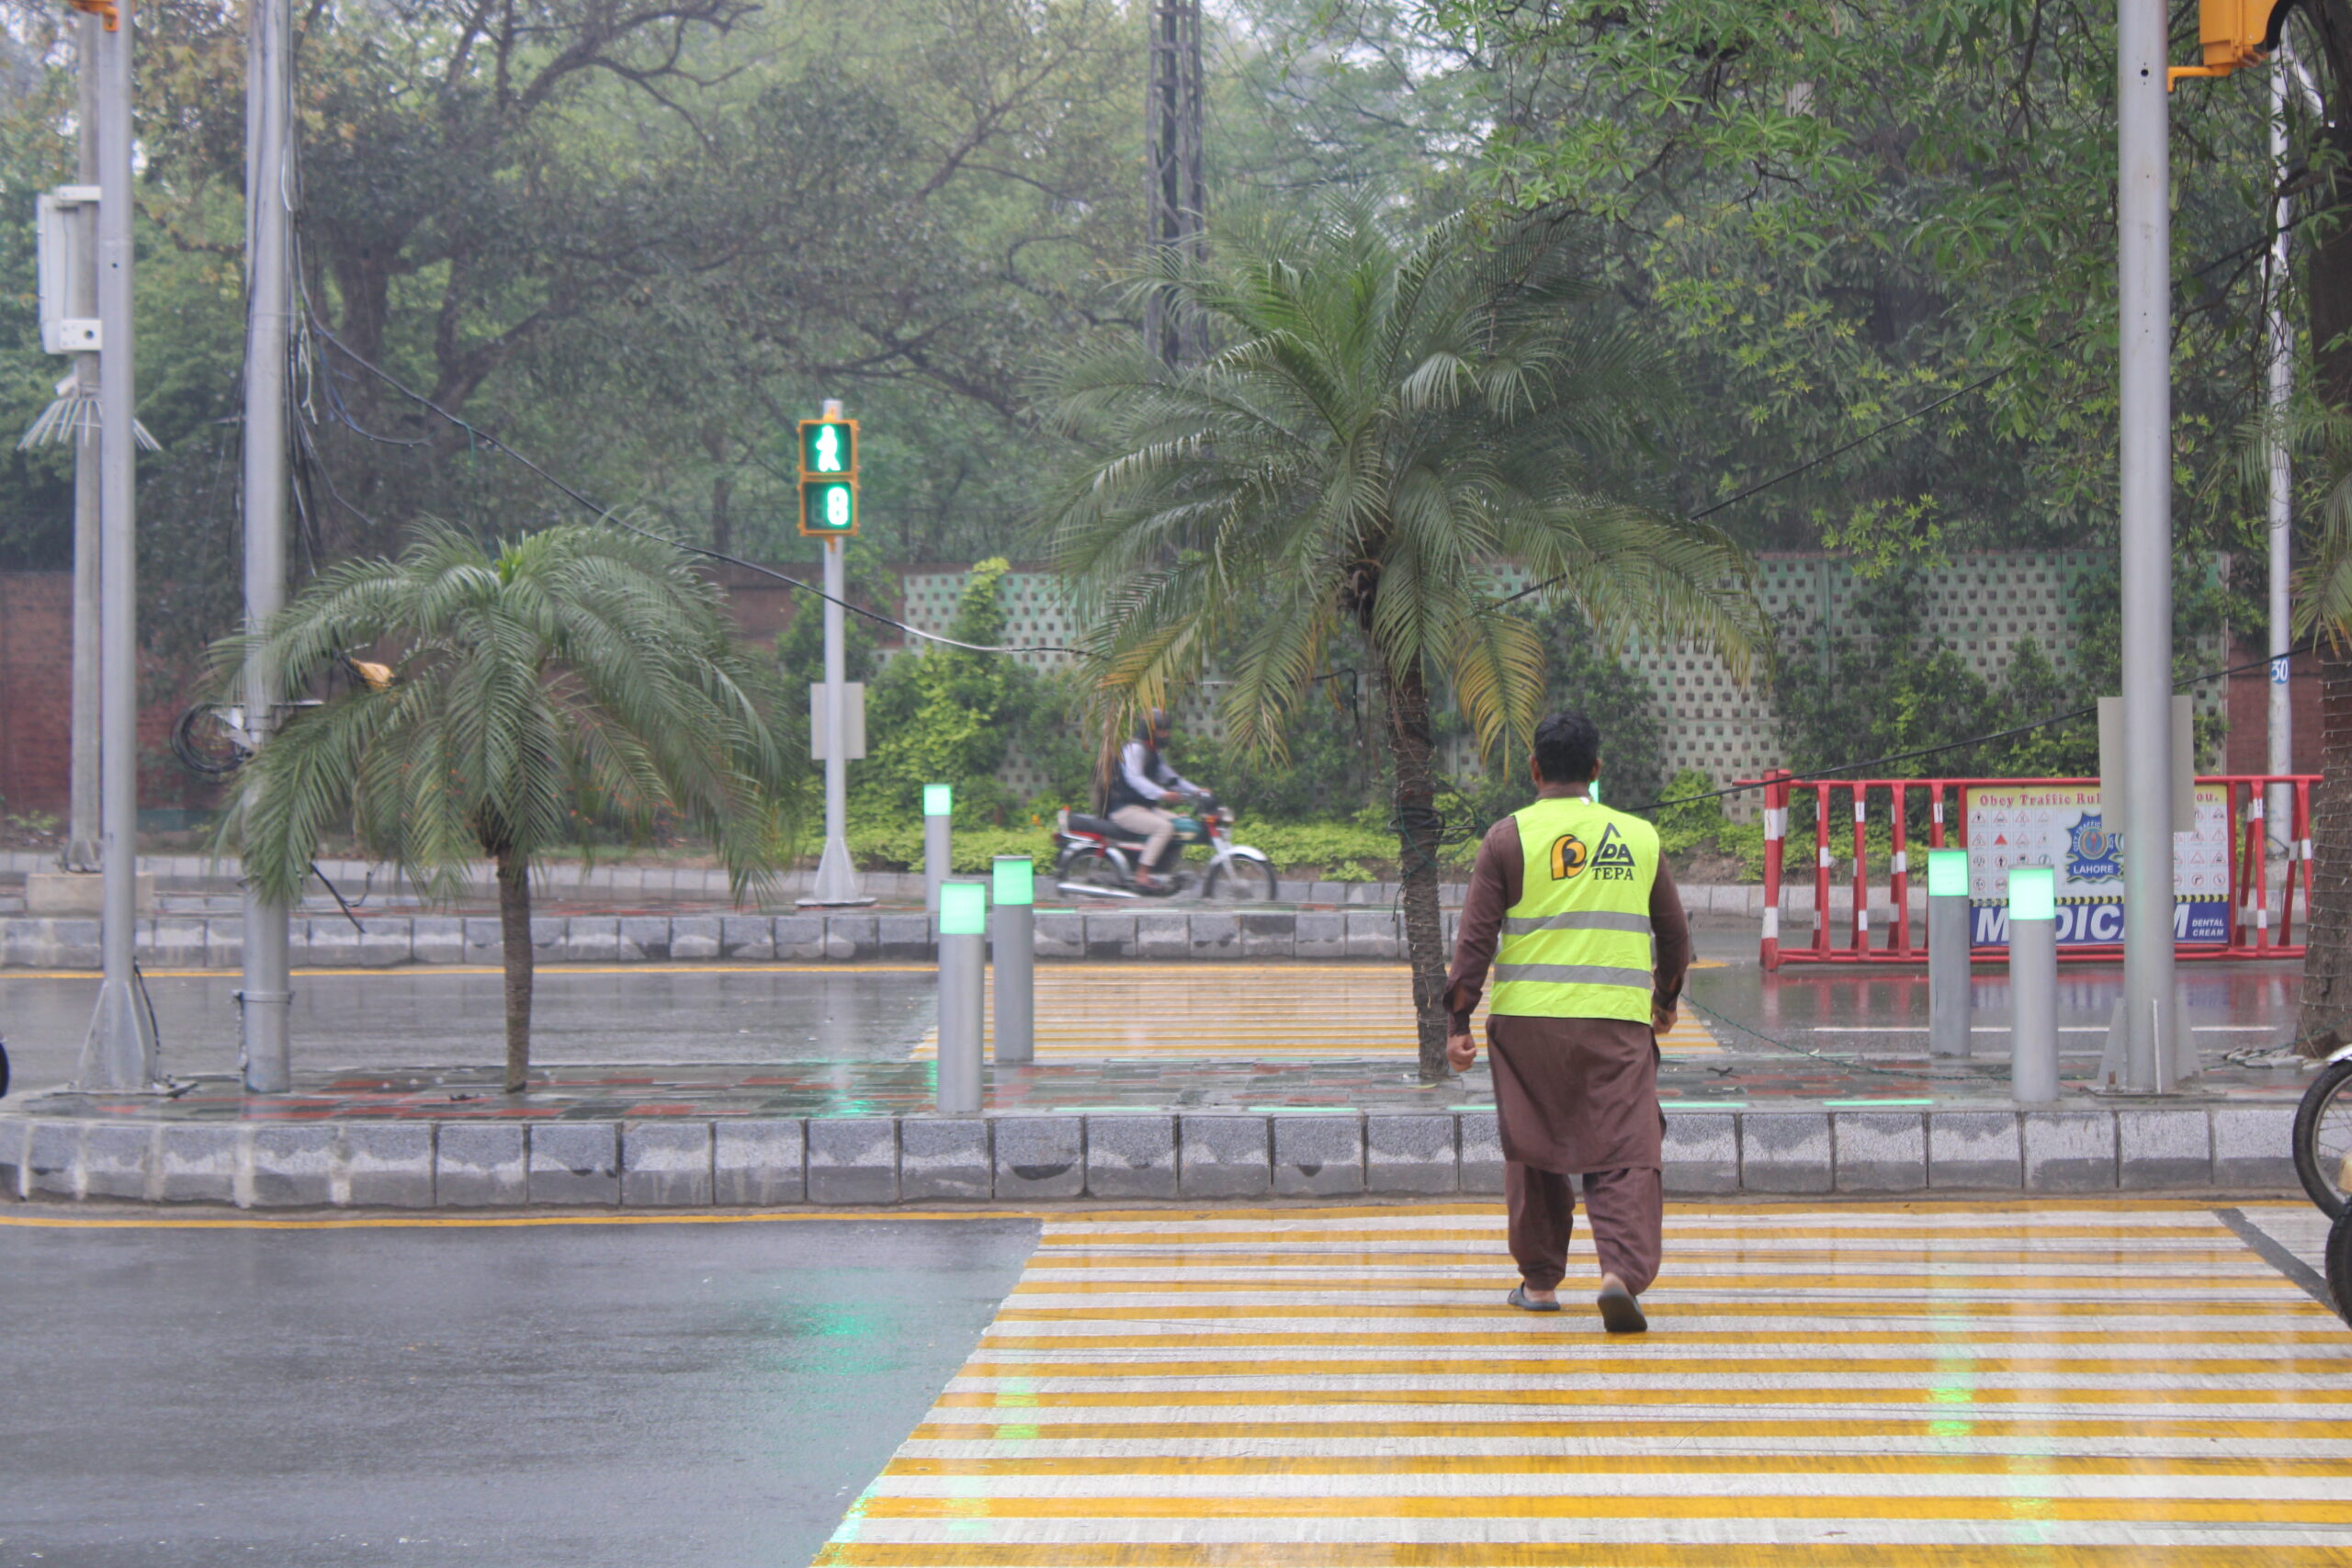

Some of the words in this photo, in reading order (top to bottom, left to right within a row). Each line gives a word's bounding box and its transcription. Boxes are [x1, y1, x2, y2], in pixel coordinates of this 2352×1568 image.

[827, 487, 849, 525] 8
[1979, 795, 2013, 807] Obey
[2019, 794, 2071, 806] Traffic
[2076, 793, 2101, 804] Rul
[2196, 793, 2219, 802] ou.
[1592, 867, 1634, 881] TEPA
[2073, 864, 2114, 874] LAHORE
[1975, 904, 2190, 942] MDICM
[2192, 919, 2224, 927] DENTAL
[2192, 929, 2224, 937] CREAM
